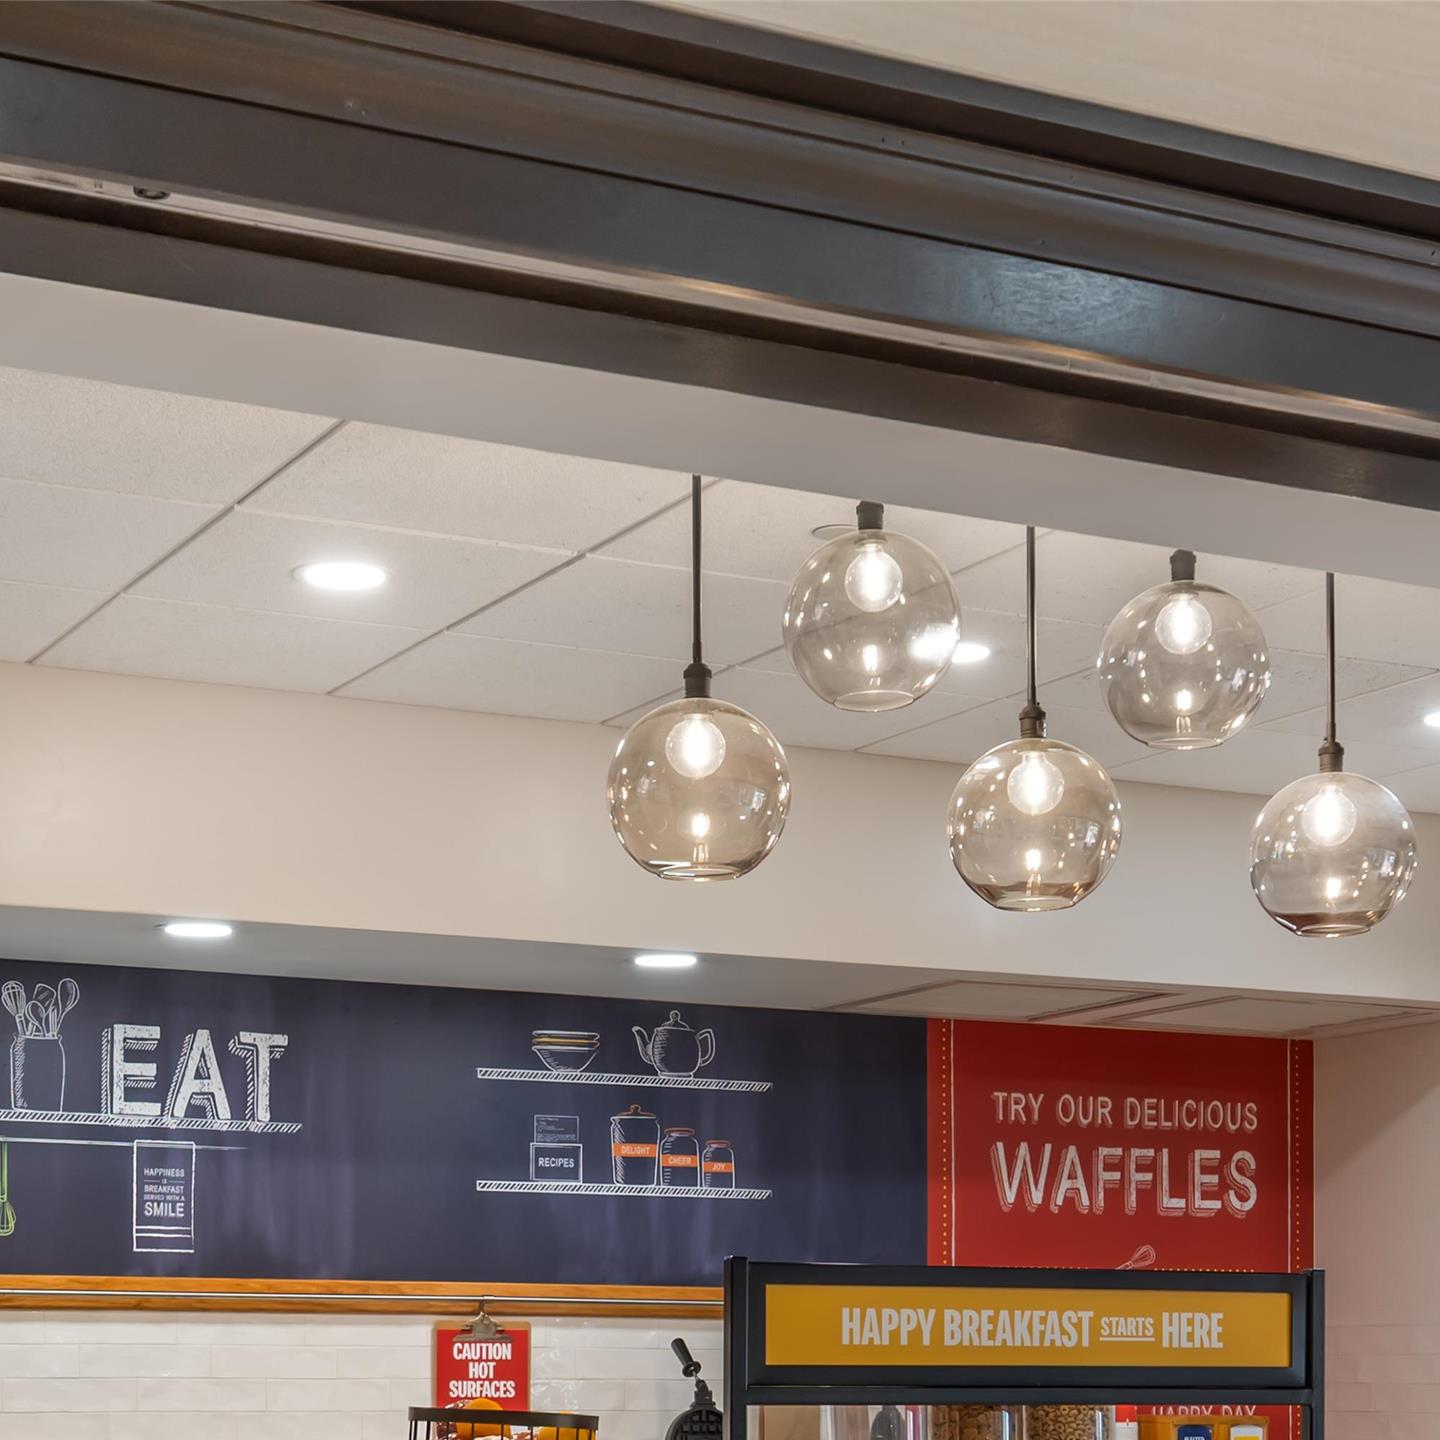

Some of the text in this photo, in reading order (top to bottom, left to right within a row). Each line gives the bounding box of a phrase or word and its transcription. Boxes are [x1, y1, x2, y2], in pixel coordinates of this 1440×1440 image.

[106, 1023, 289, 1122] EAT
[992, 1091, 1258, 1132] TRY OUR DELICIOUS
[621, 1146, 651, 1156] DELIGHT
[538, 1156, 575, 1168] RECIPES
[667, 1155, 692, 1165] CHEER
[712, 1162, 726, 1171] JOY
[143, 1167, 185, 1178] HAPPINESS
[992, 1141, 1258, 1216] WAFFLES
[144, 1184, 185, 1194] BREAKFAST
[144, 1201, 185, 1218] SMILE
[841, 1307, 1224, 1349] HAPPY BREAKFAST STARTS HERE
[453, 1342, 512, 1360] CAUTION
[468, 1362, 496, 1379] HOT
[449, 1380, 516, 1398] SURFACES
